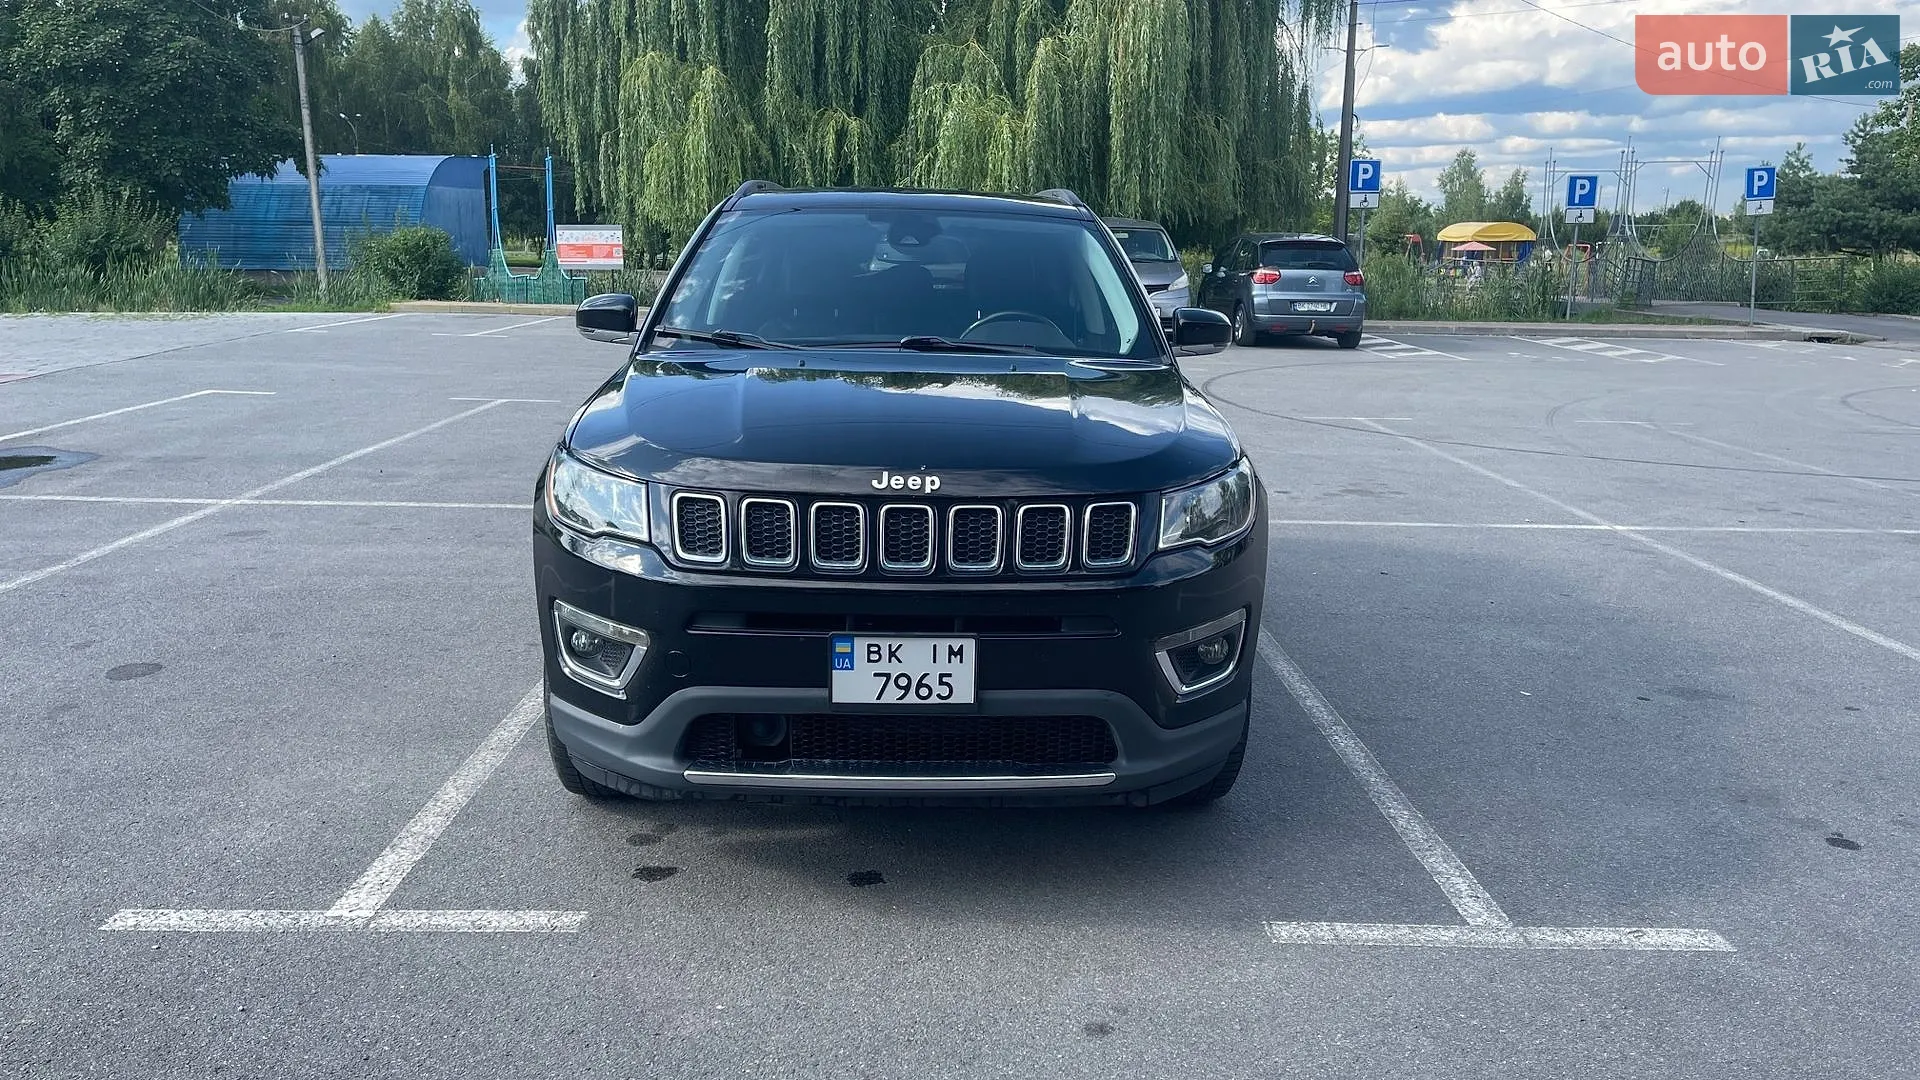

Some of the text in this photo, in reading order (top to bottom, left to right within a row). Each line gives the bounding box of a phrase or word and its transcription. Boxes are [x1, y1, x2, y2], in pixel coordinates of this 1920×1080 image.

[1357, 163, 1373, 188] P
[1753, 170, 1769, 195] P
[1574, 178, 1590, 204] P
[871, 471, 941, 493] Jeep
[835, 658, 851, 669] UA
[866, 643, 964, 664] BK IM
[872, 672, 954, 701] 7965
